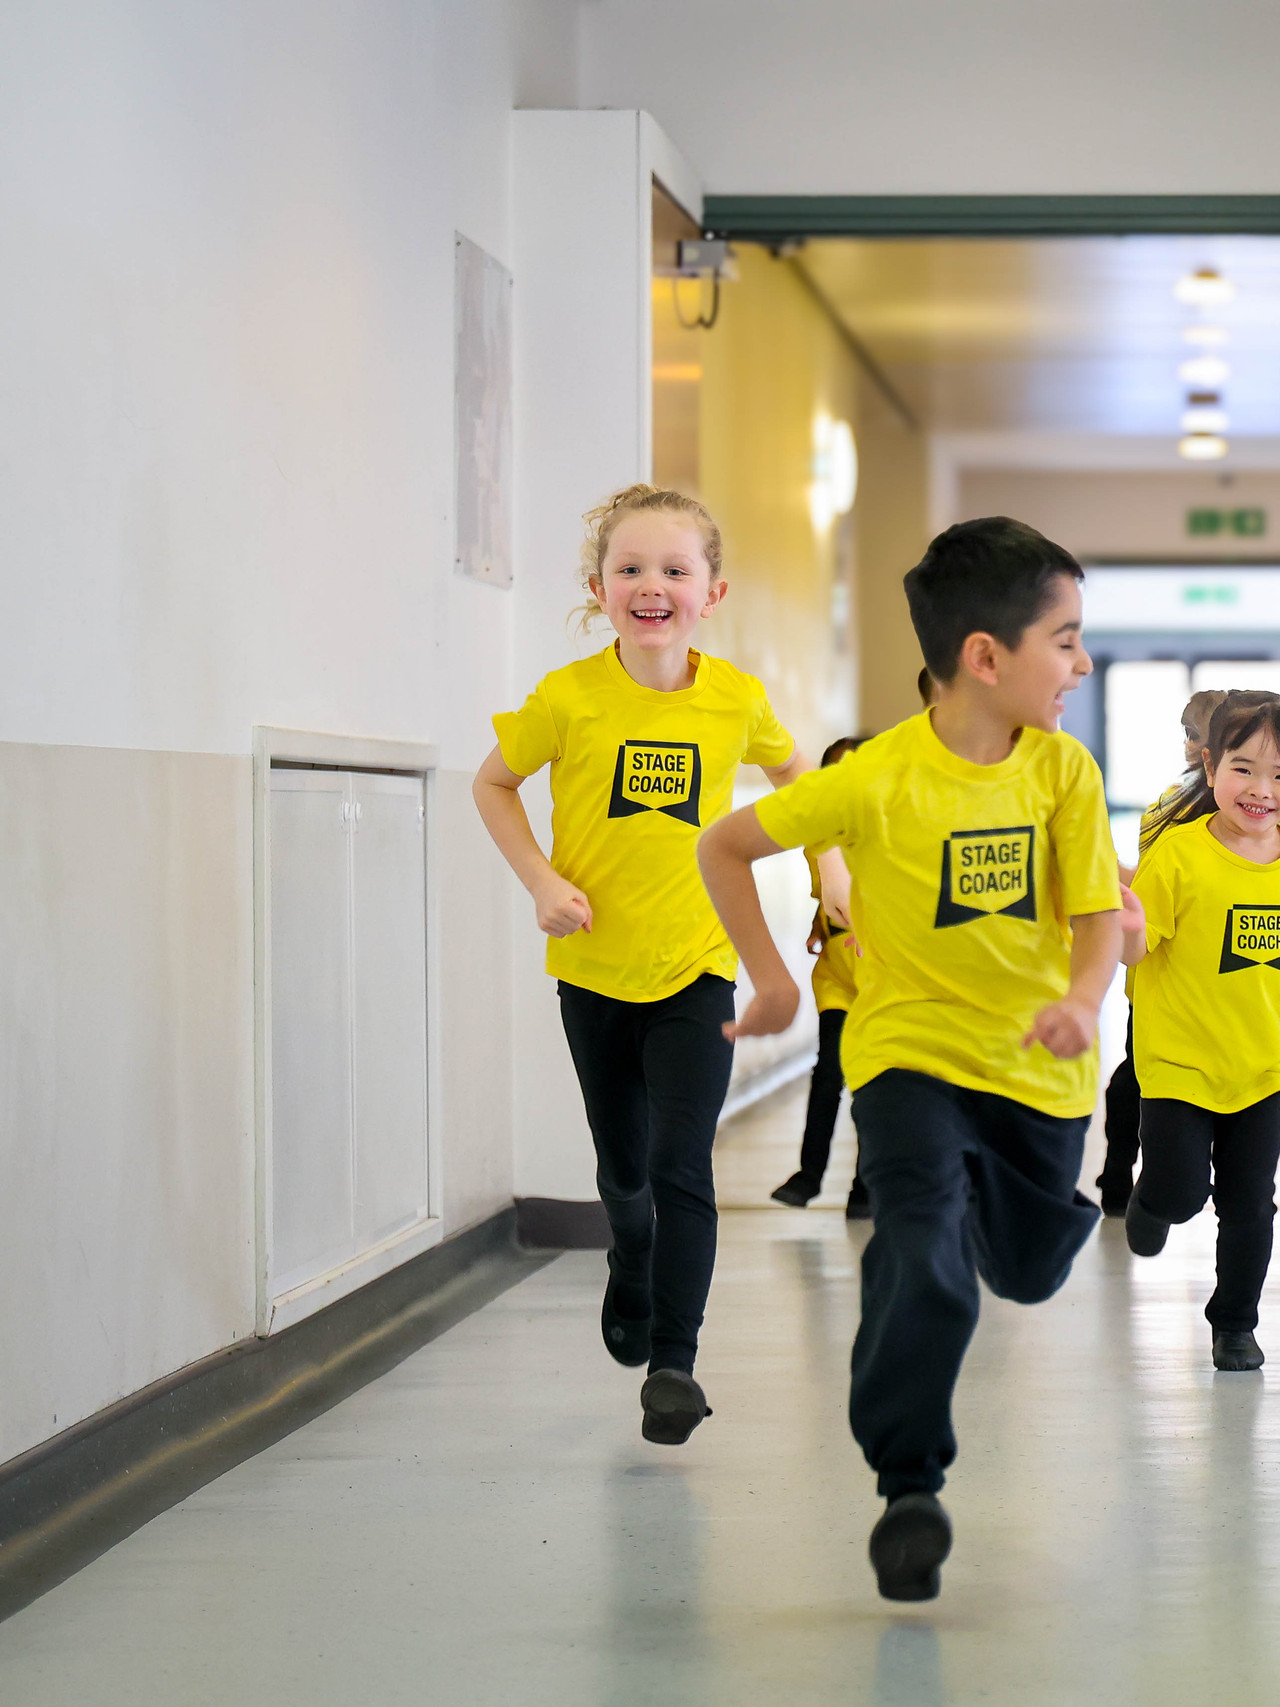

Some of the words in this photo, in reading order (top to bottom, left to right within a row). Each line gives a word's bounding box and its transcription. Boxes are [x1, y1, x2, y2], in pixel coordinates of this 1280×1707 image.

[631, 752, 686, 774] STAGE
[628, 775, 686, 795] COACH
[961, 842, 1022, 866] STAGE
[959, 868, 1022, 895] COACH
